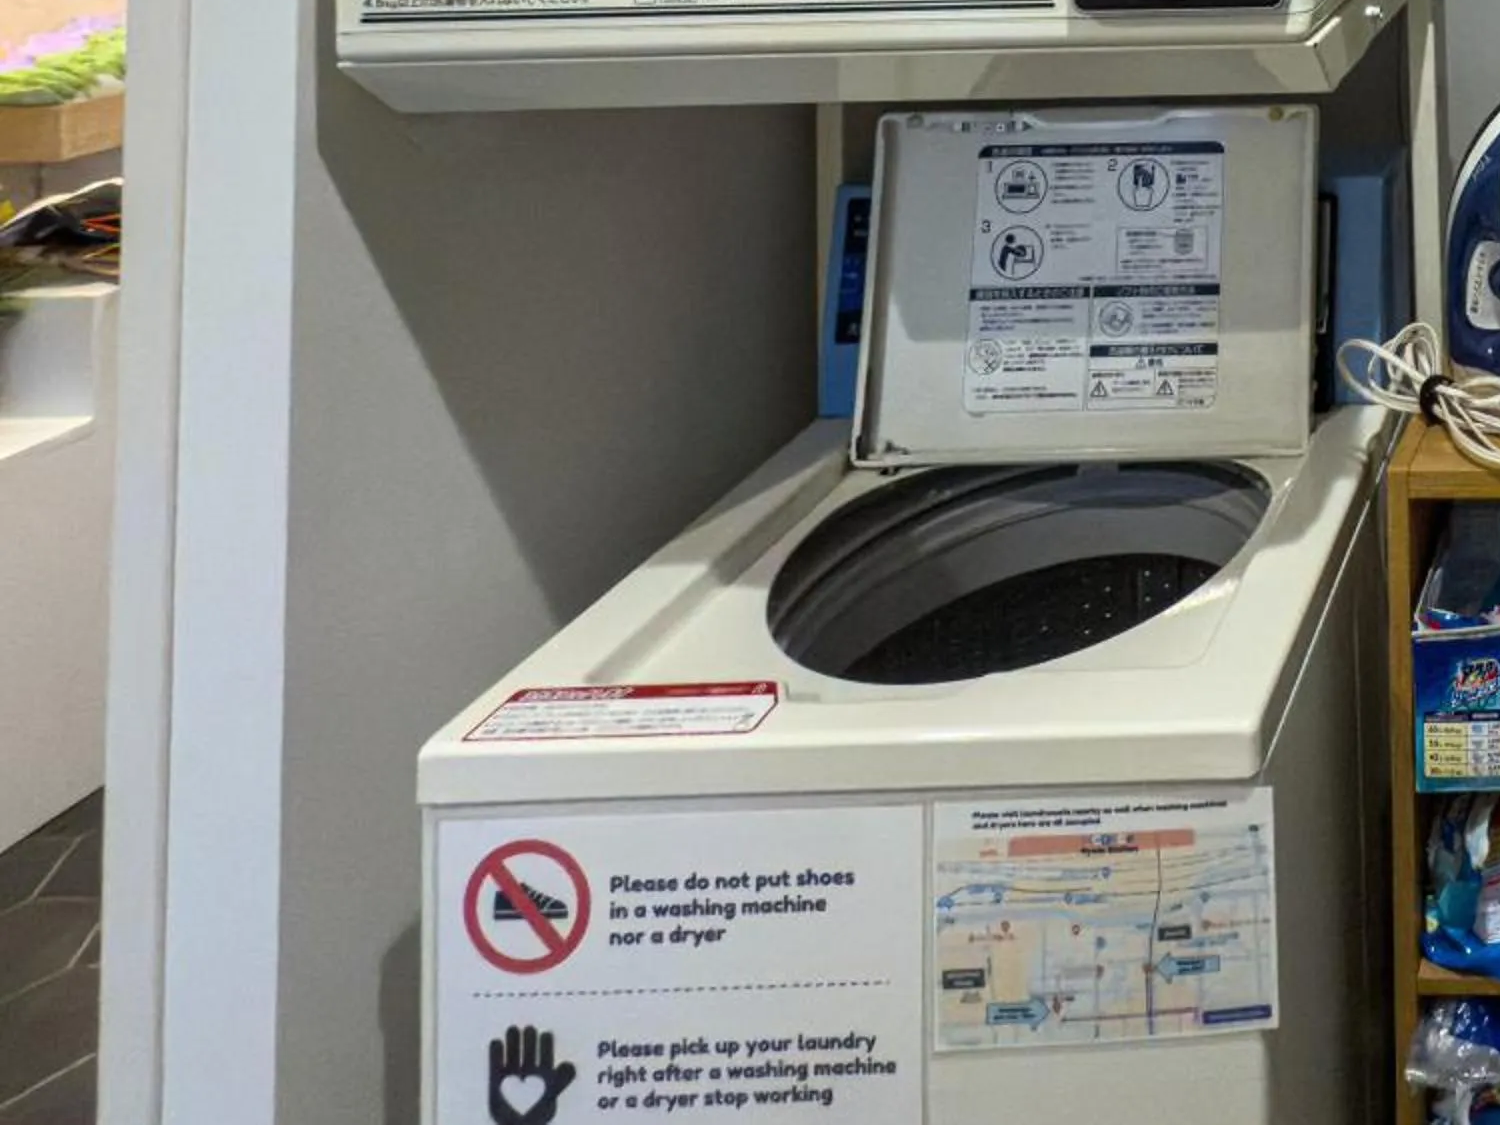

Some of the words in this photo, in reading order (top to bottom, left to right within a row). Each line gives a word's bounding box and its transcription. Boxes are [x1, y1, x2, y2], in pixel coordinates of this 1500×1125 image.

[1107, 158, 1118, 172] 2
[981, 220, 992, 234] 3
[610, 875, 678, 893] Please
[684, 872, 709, 890] do
[715, 873, 750, 889] not
[756, 871, 790, 892] put
[797, 869, 854, 886] shoes
[610, 902, 628, 919] in
[634, 906, 646, 918] a
[652, 898, 736, 920] washing
[742, 895, 826, 914] machine
[610, 932, 644, 946] nor
[651, 932, 663, 944] a
[669, 925, 726, 947] dryer
[598, 1040, 664, 1058] Please
[670, 1038, 709, 1060] pick
[715, 1041, 740, 1057] up
[746, 1039, 792, 1058] your
[798, 1032, 876, 1053] laundry
[598, 1065, 647, 1088] right
[653, 1063, 703, 1082] after
[709, 1068, 721, 1079] a
[727, 1060, 808, 1081] washing
[814, 1058, 896, 1076] machine
[598, 1097, 619, 1109] or
[626, 1096, 637, 1108] a
[643, 1091, 698, 1112] dryer
[704, 1089, 748, 1109] stop
[753, 1085, 833, 1106] working
